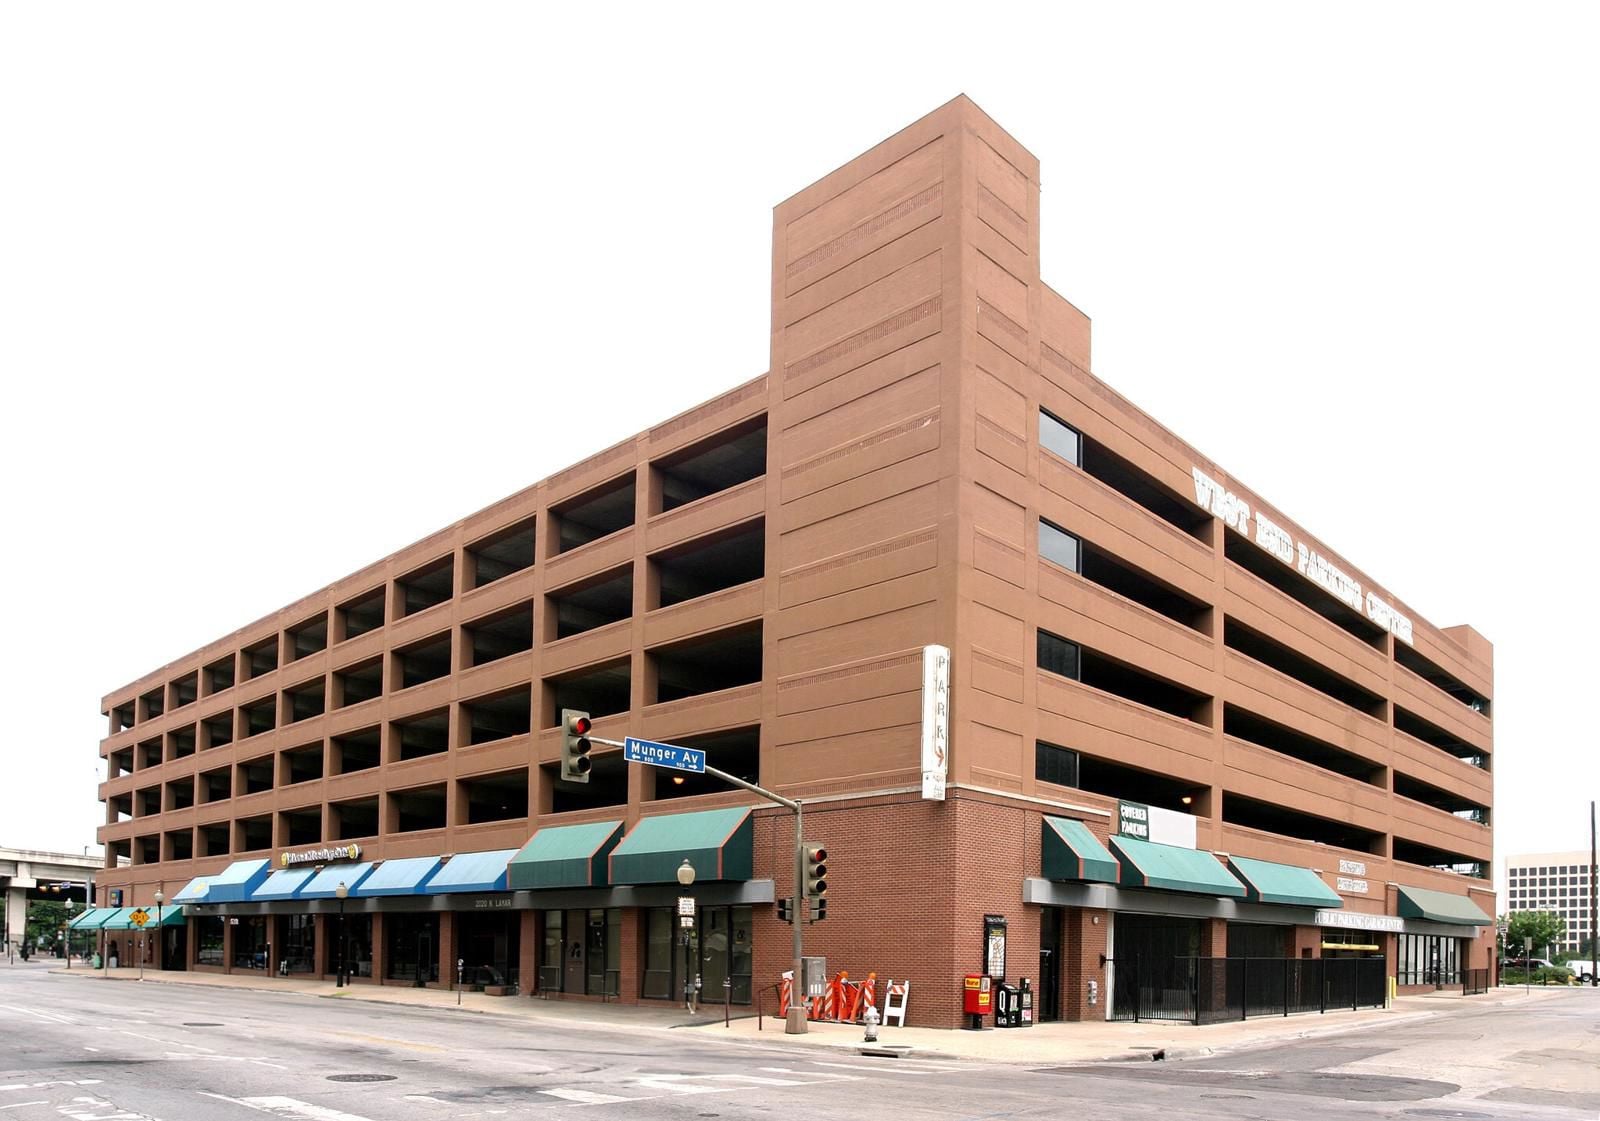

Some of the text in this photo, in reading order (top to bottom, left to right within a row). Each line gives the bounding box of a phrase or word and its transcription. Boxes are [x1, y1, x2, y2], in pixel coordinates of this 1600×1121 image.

[1192, 466, 1250, 536] WEST
[1255, 511, 1294, 565] END
[1297, 541, 1363, 612] PARKING
[936, 655, 946, 741] PARK
[631, 741, 698, 764] Munger Av
[1121, 821, 1148, 837] PARKING
